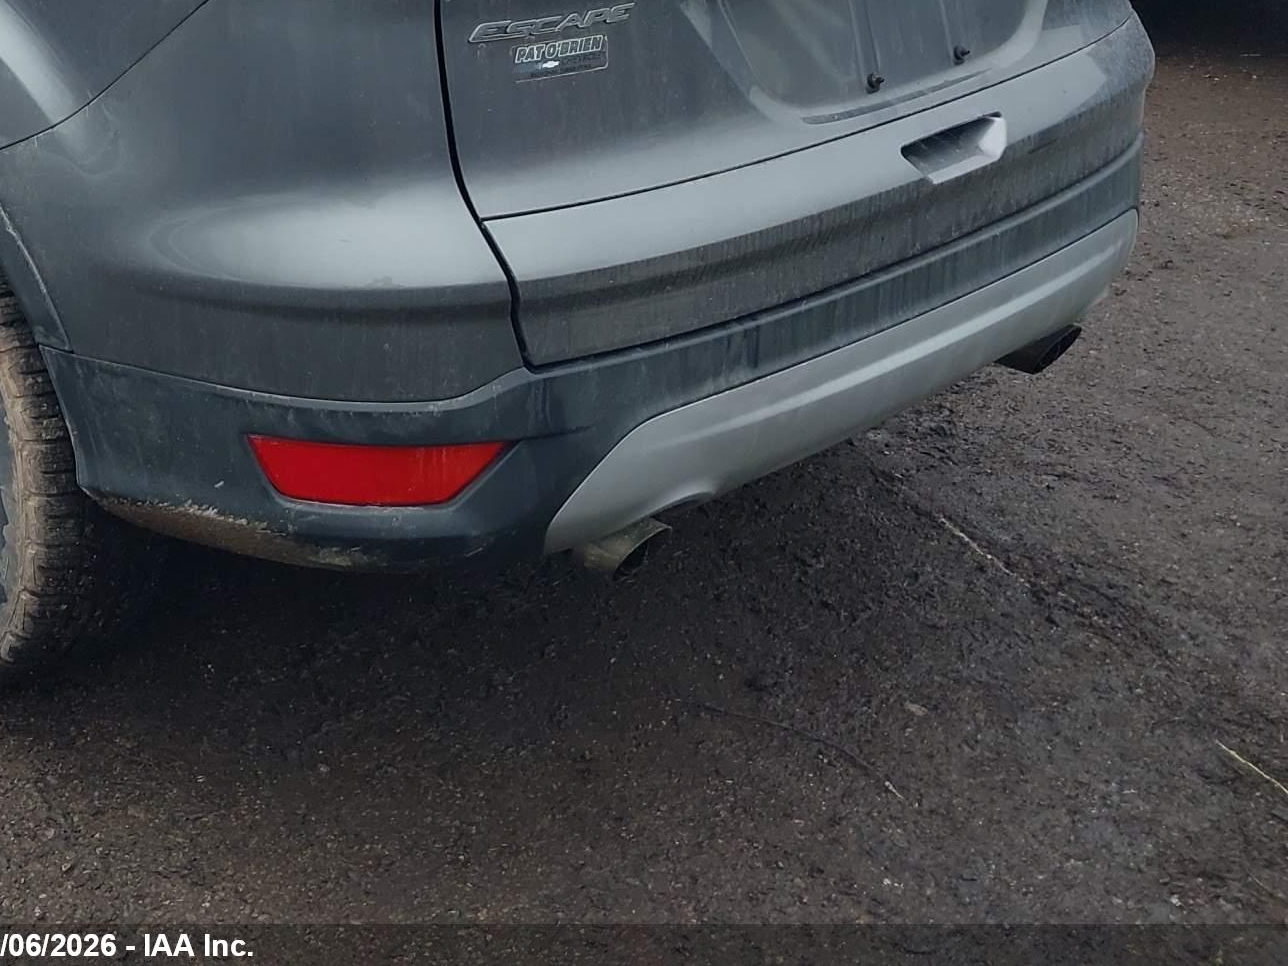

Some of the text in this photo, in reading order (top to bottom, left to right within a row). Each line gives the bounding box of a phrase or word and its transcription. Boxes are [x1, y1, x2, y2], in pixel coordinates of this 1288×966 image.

[469, 2, 636, 42] ESCAPE
[515, 44, 546, 63] PAT
[546, 35, 603, 59] O'BRIEN
